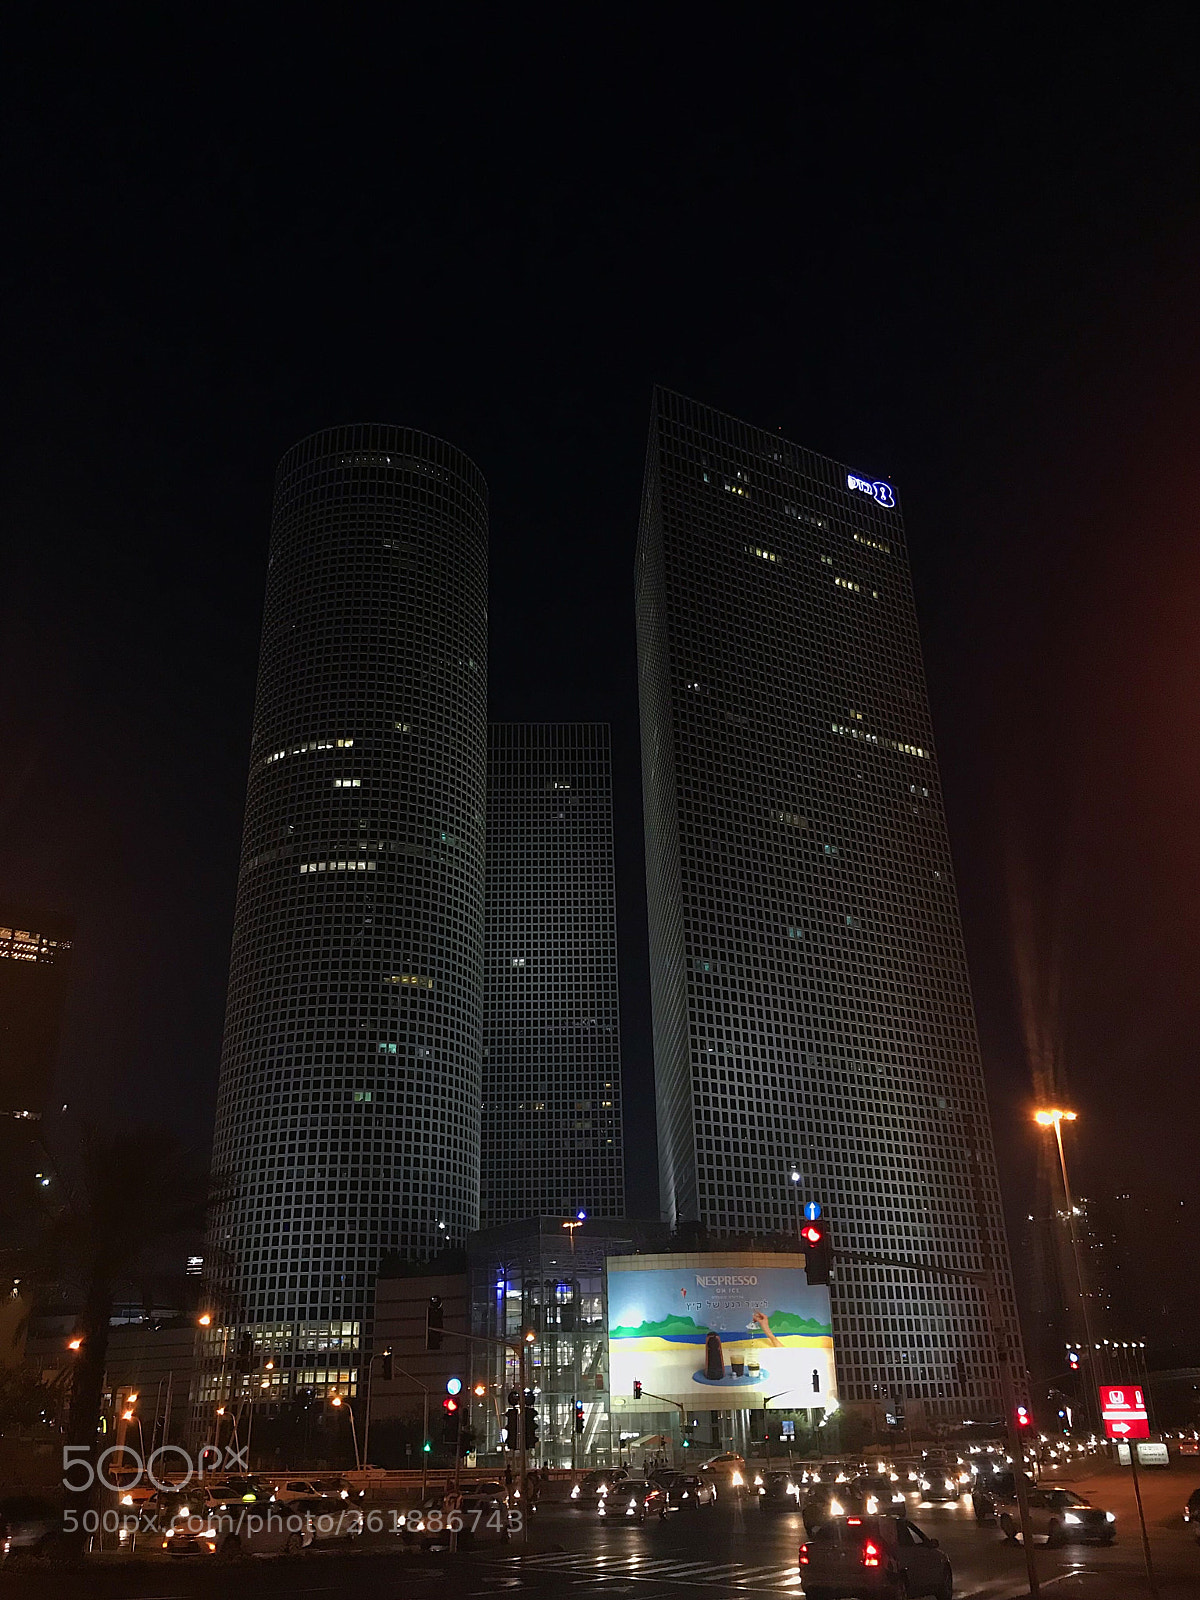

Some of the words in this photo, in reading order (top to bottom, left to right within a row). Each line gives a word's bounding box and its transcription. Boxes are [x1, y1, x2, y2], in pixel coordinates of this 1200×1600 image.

[696, 1274, 758, 1287] NESPRESSO
[686, 1301, 702, 1311] קיץ
[706, 1300, 720, 1309] של
